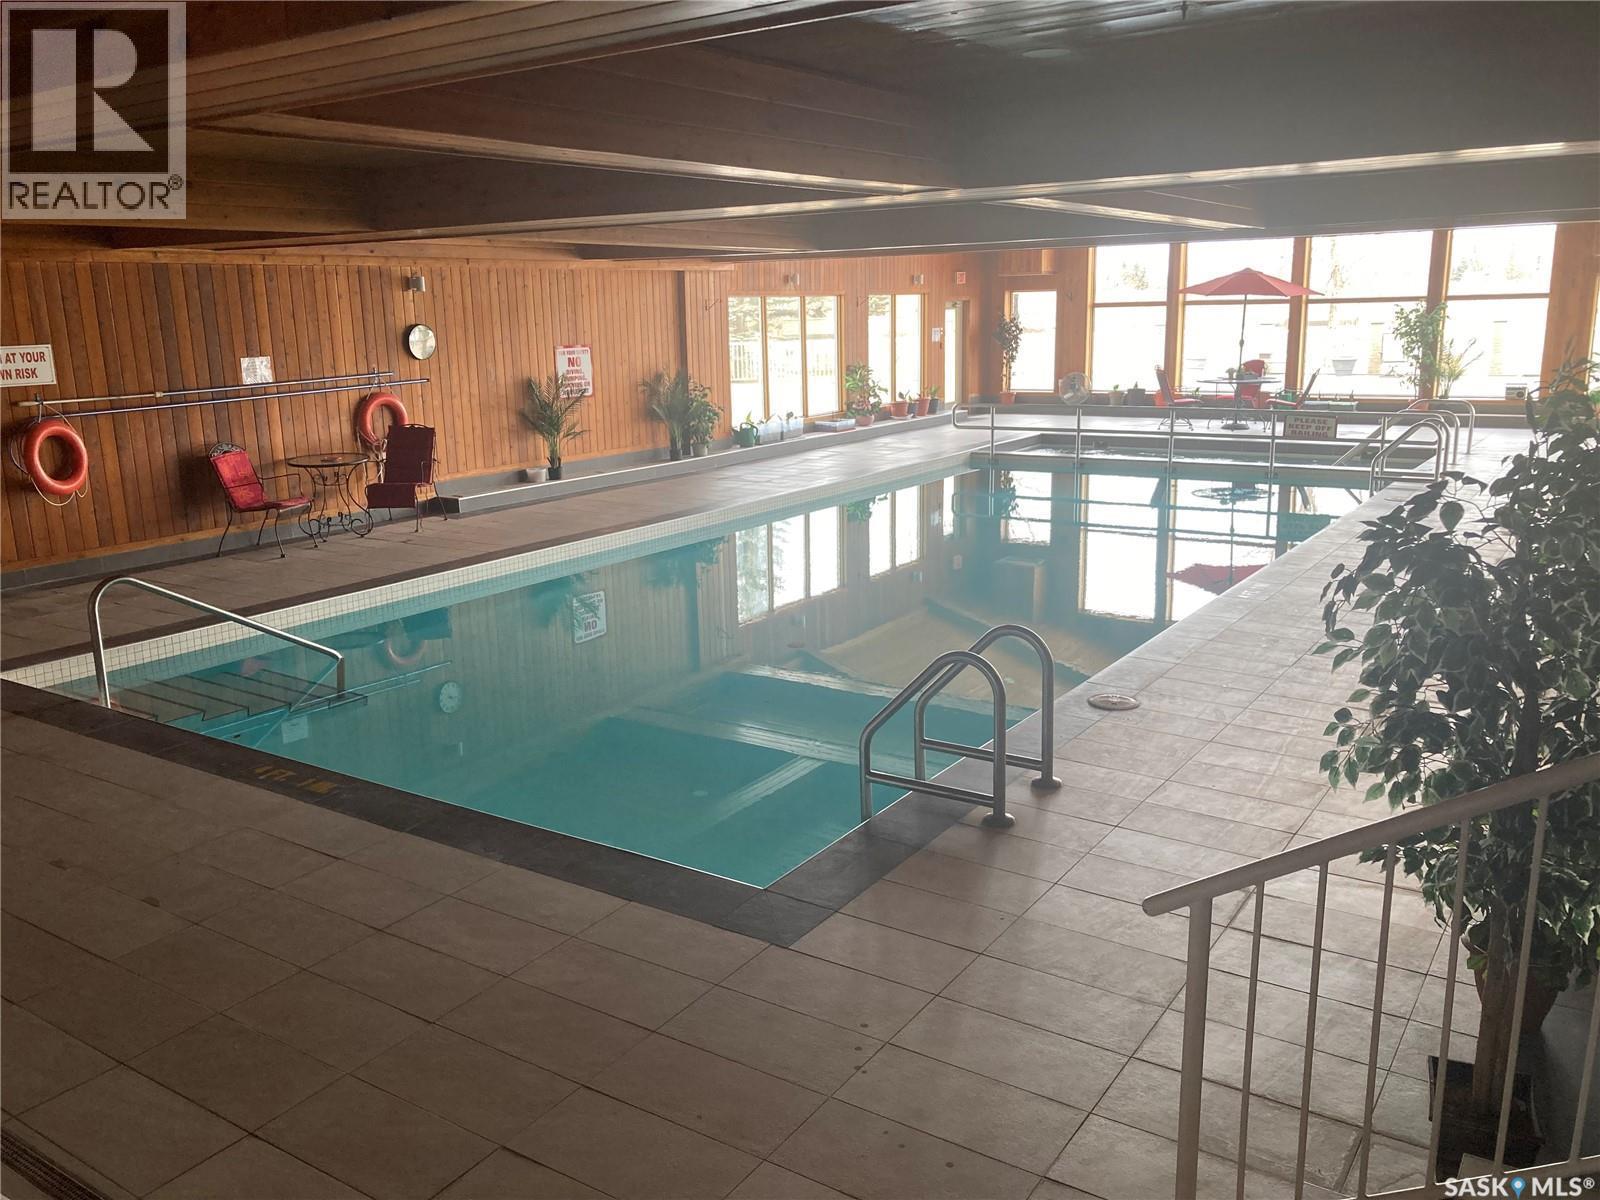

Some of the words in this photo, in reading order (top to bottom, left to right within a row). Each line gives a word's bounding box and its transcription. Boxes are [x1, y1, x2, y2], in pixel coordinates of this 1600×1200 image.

[5, 352, 17, 364] AT
[19, 351, 46, 363] YOUR
[568, 356, 581, 368] NO
[15, 367, 38, 379] RISK
[1294, 417, 1329, 425] PLEASE
[1290, 430, 1329, 438] RAILING
